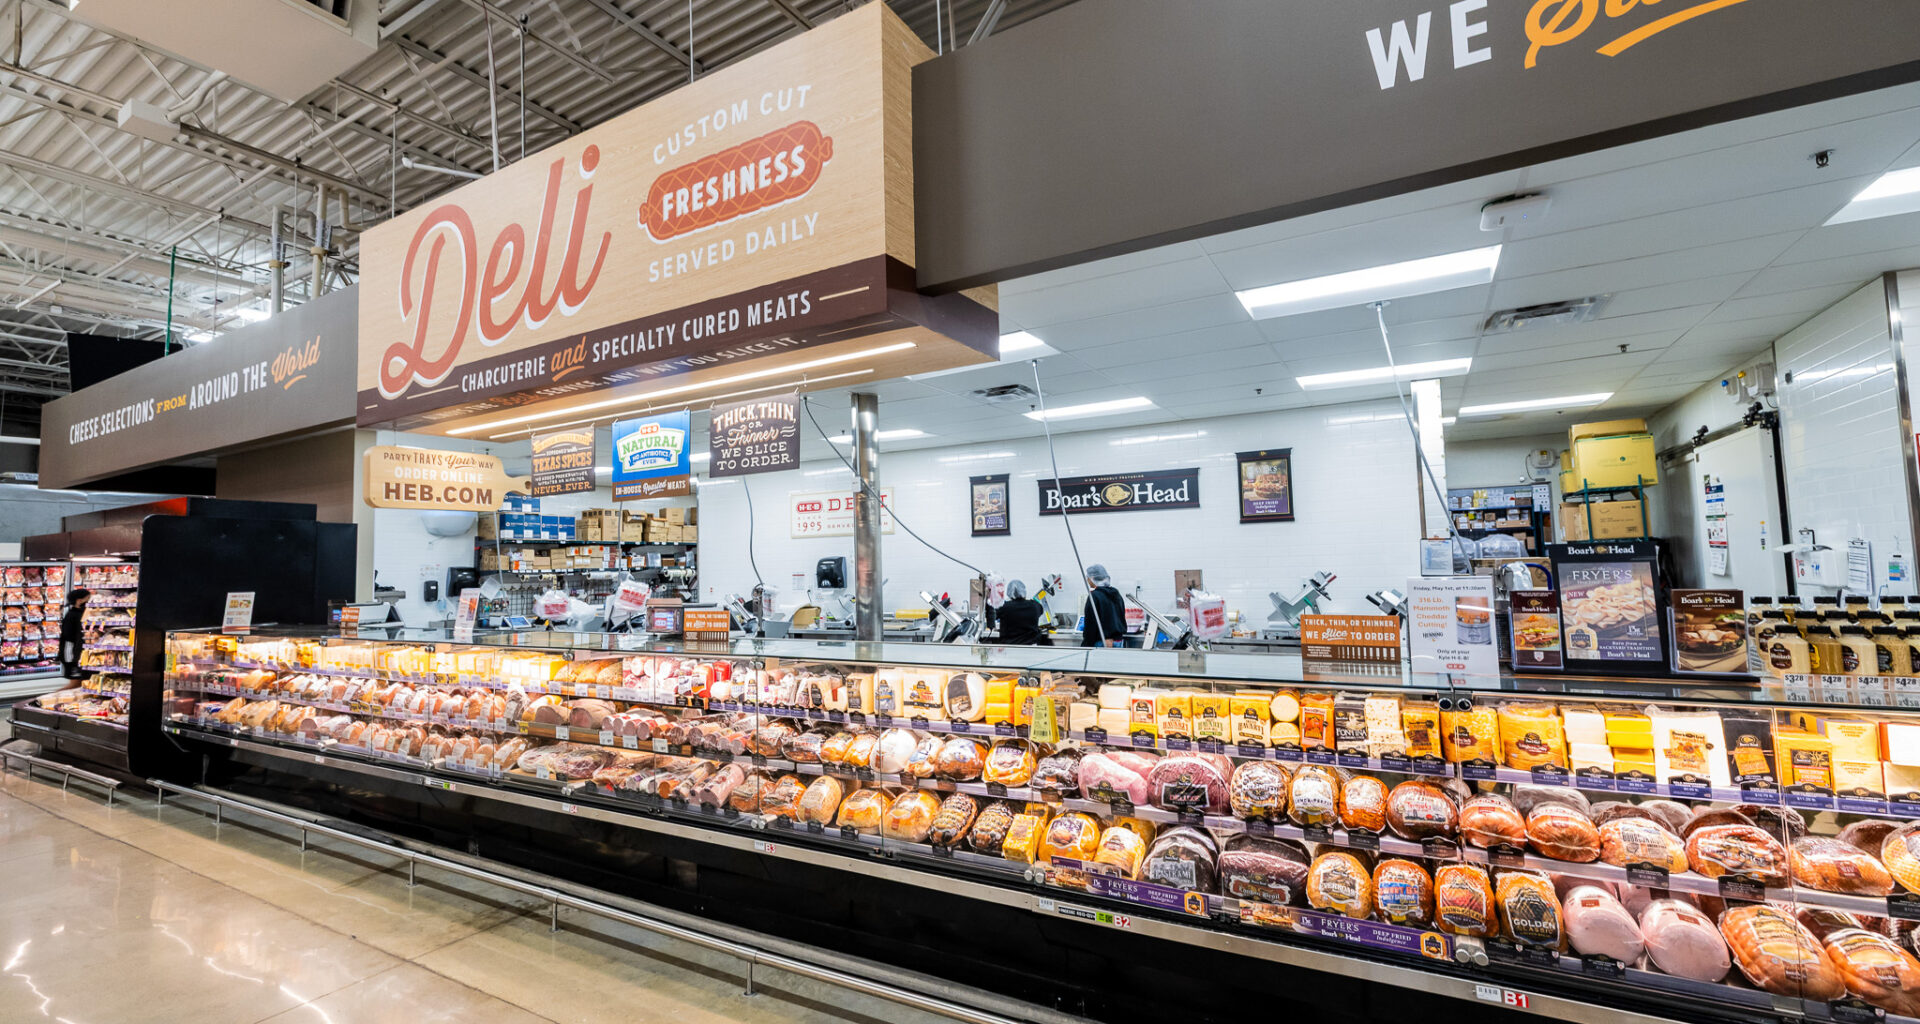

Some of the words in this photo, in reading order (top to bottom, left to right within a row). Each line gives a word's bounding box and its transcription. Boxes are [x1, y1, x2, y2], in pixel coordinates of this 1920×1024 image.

[1366, 0, 1491, 90] WE
[653, 99, 749, 165] CUSTOM
[760, 85, 812, 114] CUT
[661, 143, 807, 222] FRESHNESS
[648, 239, 736, 283] SERVED
[745, 212, 820, 255] DAILY
[378, 143, 612, 400] Deli
[461, 355, 546, 393] CHARCUTERIE
[551, 336, 587, 373] and
[592, 323, 676, 363] SPECIALTY
[682, 308, 740, 342] CURED
[747, 290, 811, 328] MEATS
[636, 361, 677, 376] WAY
[675, 355, 719, 368] YOU
[716, 342, 777, 359] SLICE
[772, 336, 807, 348] IT.
[69, 415, 99, 446] CHEESE
[100, 397, 155, 436] SELECTIONS
[156, 394, 187, 414] FROM
[189, 372, 239, 411] AROUND
[243, 361, 267, 393] THE
[271, 335, 322, 384] World
[713, 403, 759, 433] THICK,
[758, 401, 797, 424] THIN,
[748, 421, 763, 429] OR
[622, 435, 677, 455] NATURAL
[727, 424, 779, 448] Thinner
[721, 447, 741, 459] WE
[746, 441, 787, 456] SLICE
[384, 452, 412, 462] PARTY
[413, 452, 443, 466] TRAYS
[444, 453, 477, 470] Your
[479, 461, 494, 469] WAY
[533, 455, 561, 473] TEXAS
[561, 451, 593, 469] SPICES
[717, 460, 737, 471] TO
[741, 453, 794, 468] ORDER.
[394, 466, 437, 479] ORDER
[440, 470, 484, 484] ONLINE
[384, 482, 493, 505] HEB.COM
[667, 480, 686, 490] MEATS
[1046, 486, 1101, 509] Boar's
[1132, 479, 1190, 504] Head
[797, 522, 822, 532] 1905
[1567, 546, 1595, 555] Boar's
[1609, 545, 1635, 554] Head
[1572, 570, 1633, 581] FRYER'S
[1304, 618, 1327, 627] THICK,
[1329, 619, 1349, 628] THIN,
[1305, 631, 1319, 639] WE
[1350, 632, 1362, 640] TO
[1365, 632, 1396, 641] ORDER
[1114, 915, 1131, 928] B2
[1321, 918, 1360, 932] FRYER'S
[1513, 918, 1556, 930] GOLDEN
[1345, 934, 1361, 942] Head
[1373, 929, 1390, 938] DEEP
[1391, 933, 1412, 942] FRIED
[1504, 990, 1527, 1008] B1
